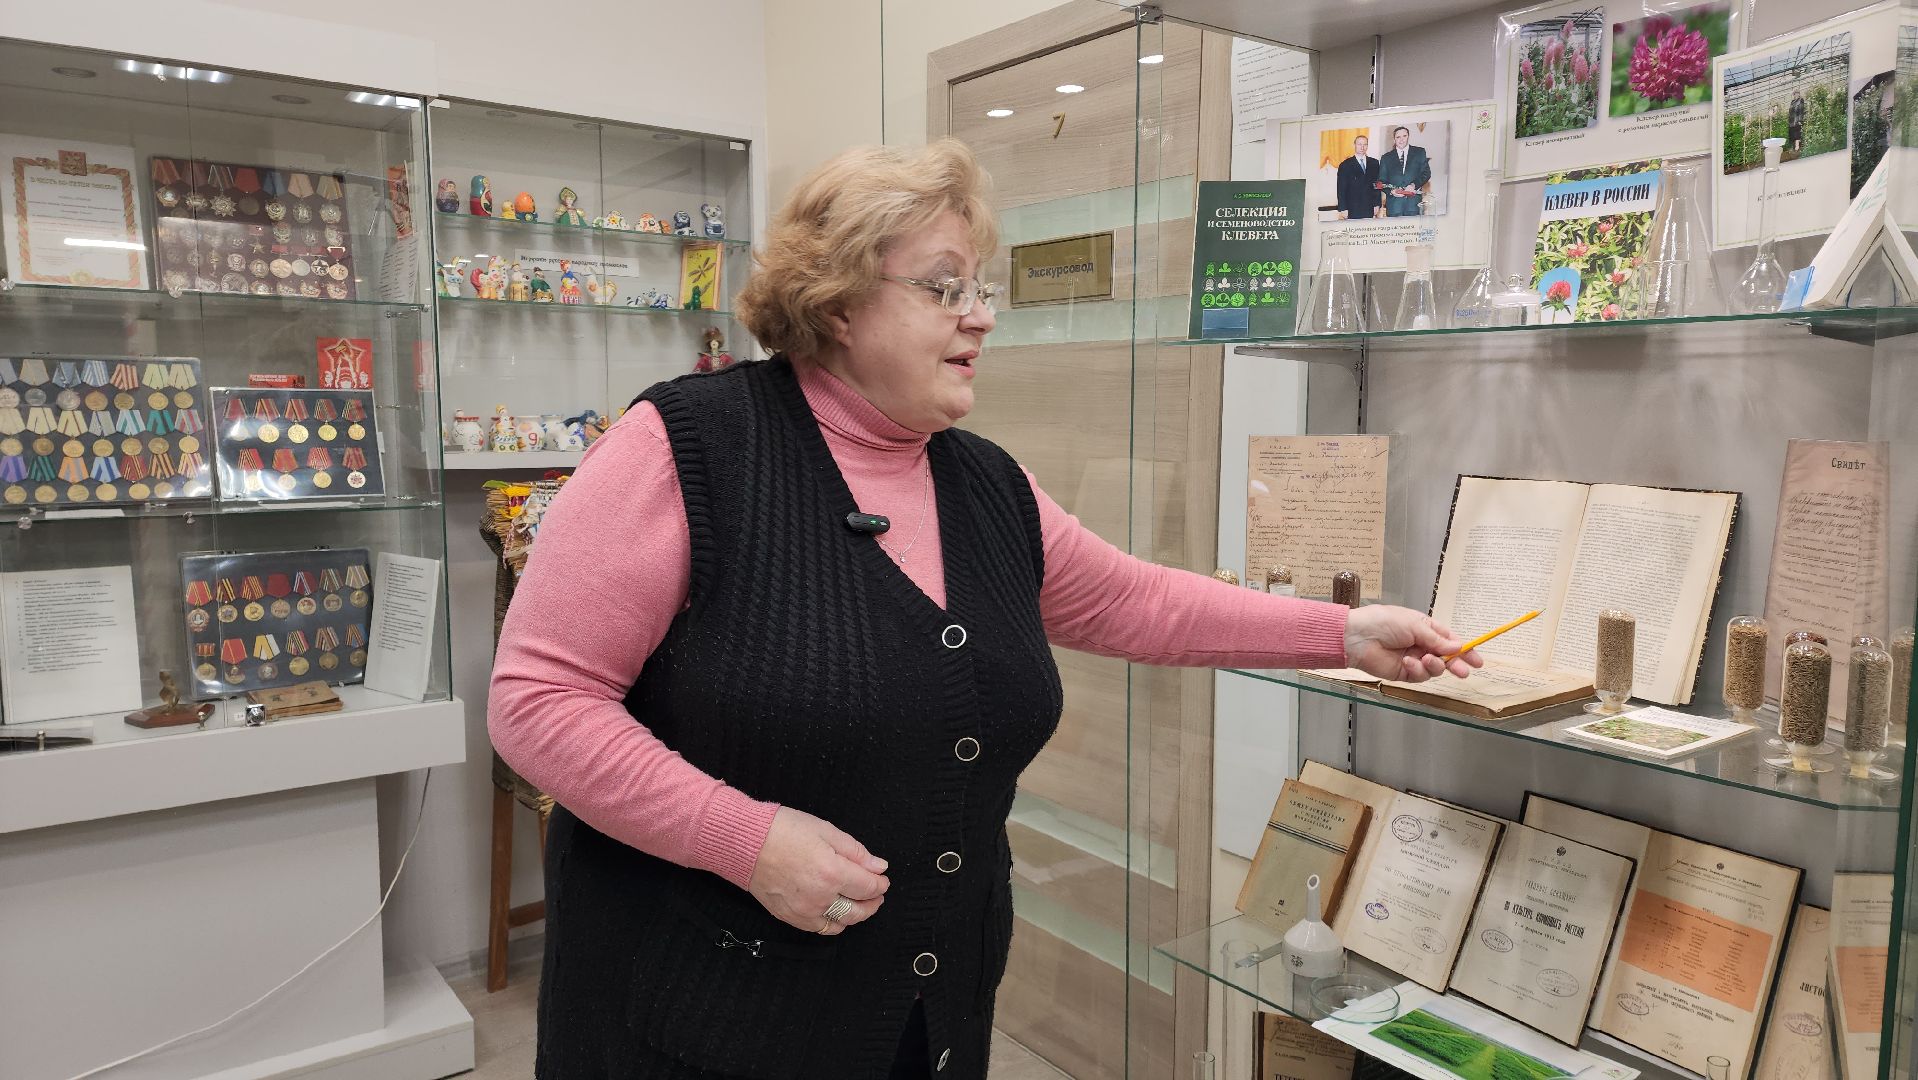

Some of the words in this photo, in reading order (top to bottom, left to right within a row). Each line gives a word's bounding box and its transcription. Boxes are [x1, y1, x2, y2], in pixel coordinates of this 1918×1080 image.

[1052, 112, 1066, 138] 7
[1544, 191, 1589, 211] КЛЕВЕР
[1592, 190, 1600, 206] В
[1603, 183, 1650, 204] РОССИИ
[1216, 206, 1287, 218] СЕЛЕКЦИЯ
[1208, 220, 1214, 228] И
[1216, 220, 1295, 228] СЕМЕНОВОДСТВО
[1222, 230, 1279, 241] КЛЕВЕРА
[1027, 262, 1094, 279] Экскурсовод
